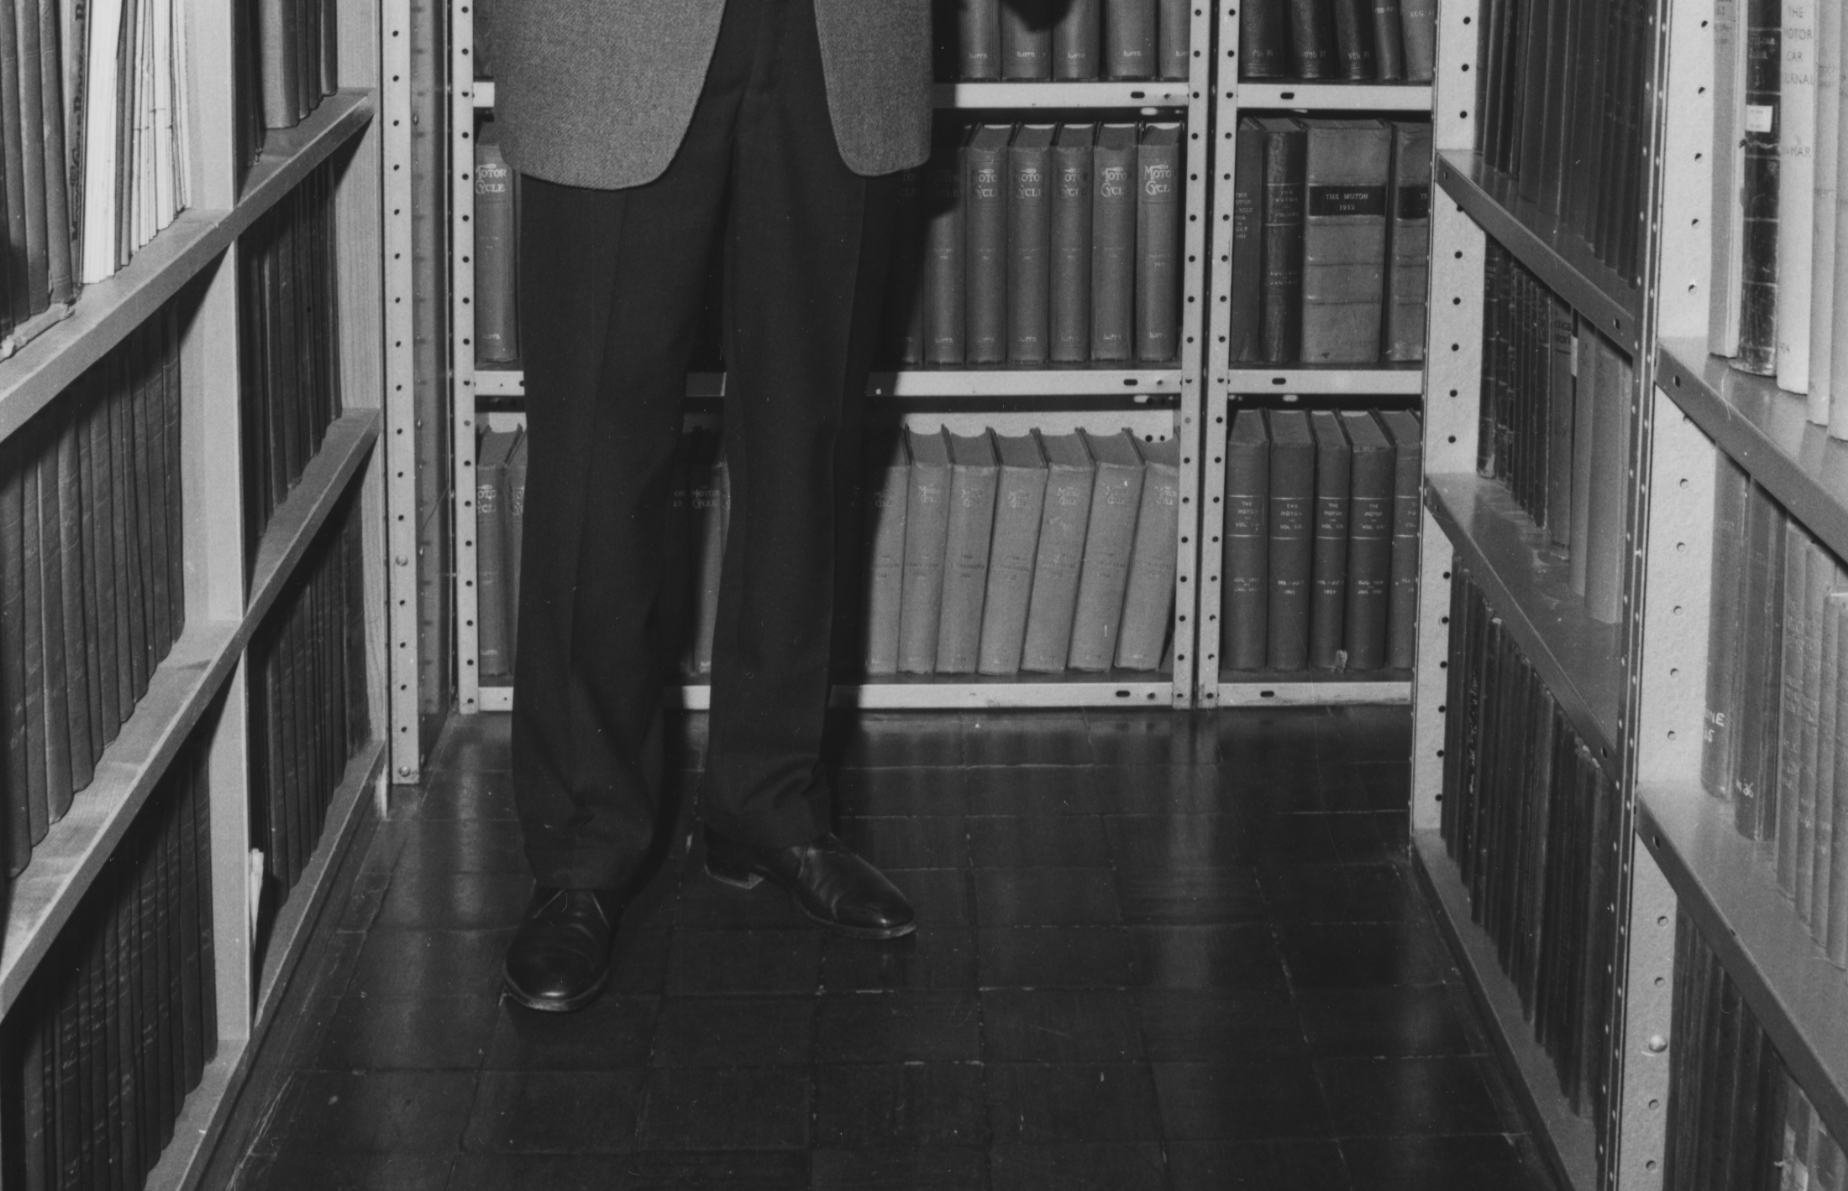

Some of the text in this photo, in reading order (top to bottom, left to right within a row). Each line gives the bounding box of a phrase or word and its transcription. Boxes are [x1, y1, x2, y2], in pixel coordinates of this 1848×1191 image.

[1788, 7, 1804, 18] THE
[1786, 51, 1803, 62] CAR
[475, 179, 506, 195] CYCLE
